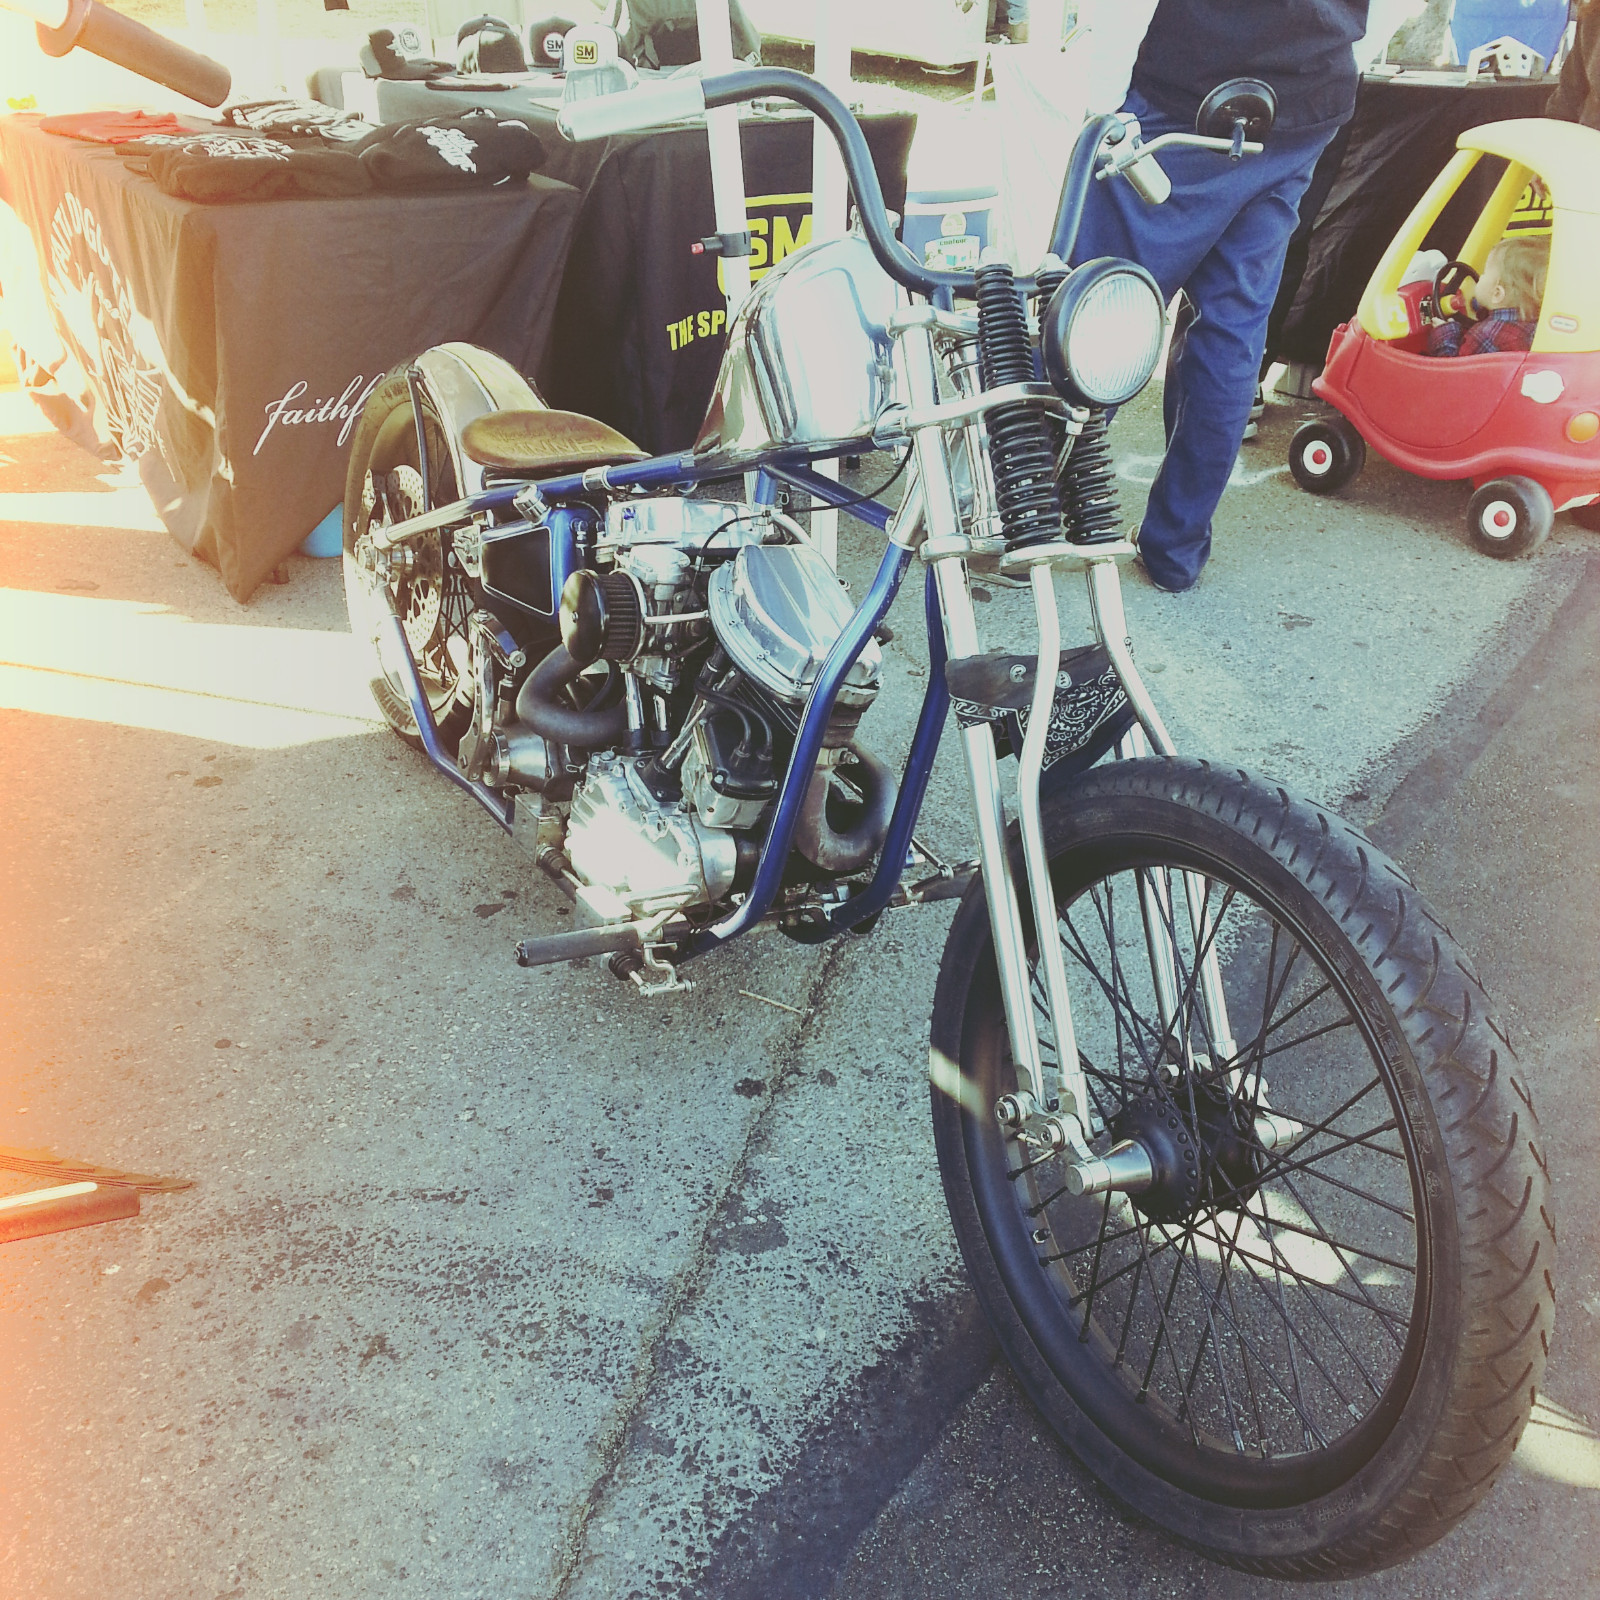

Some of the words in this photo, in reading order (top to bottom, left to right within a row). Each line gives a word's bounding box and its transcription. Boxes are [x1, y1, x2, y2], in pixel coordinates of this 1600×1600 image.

[546, 39, 564, 52] SM
[576, 45, 594, 60] SM
[666, 314, 694, 351] THE
[697, 309, 730, 338] SP
